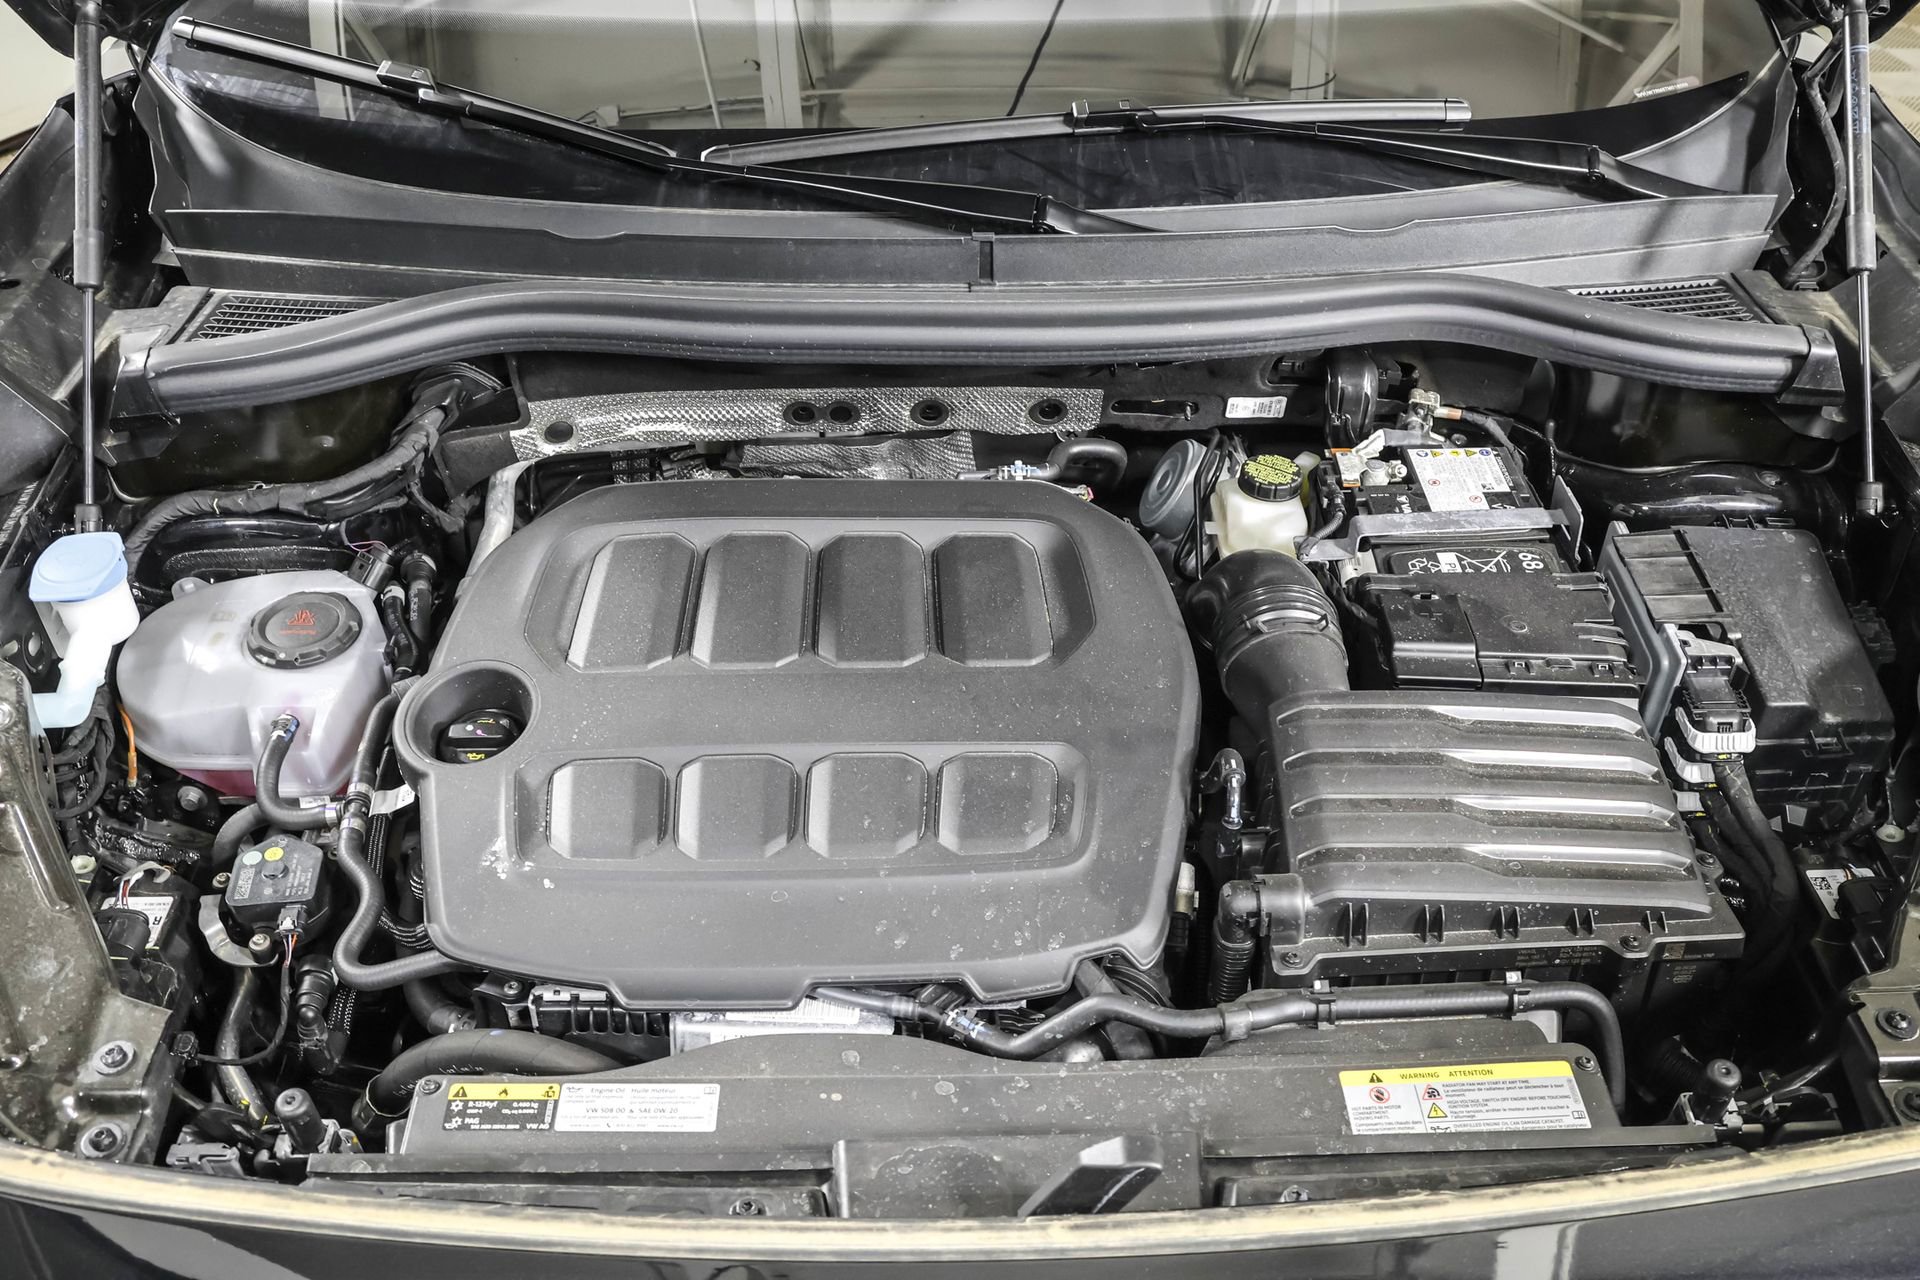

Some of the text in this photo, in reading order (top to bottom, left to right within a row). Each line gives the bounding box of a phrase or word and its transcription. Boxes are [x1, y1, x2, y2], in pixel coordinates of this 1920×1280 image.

[1400, 1069, 1494, 1080] WARNING ATTENTION
[468, 1101, 498, 1109] R-1234yf
